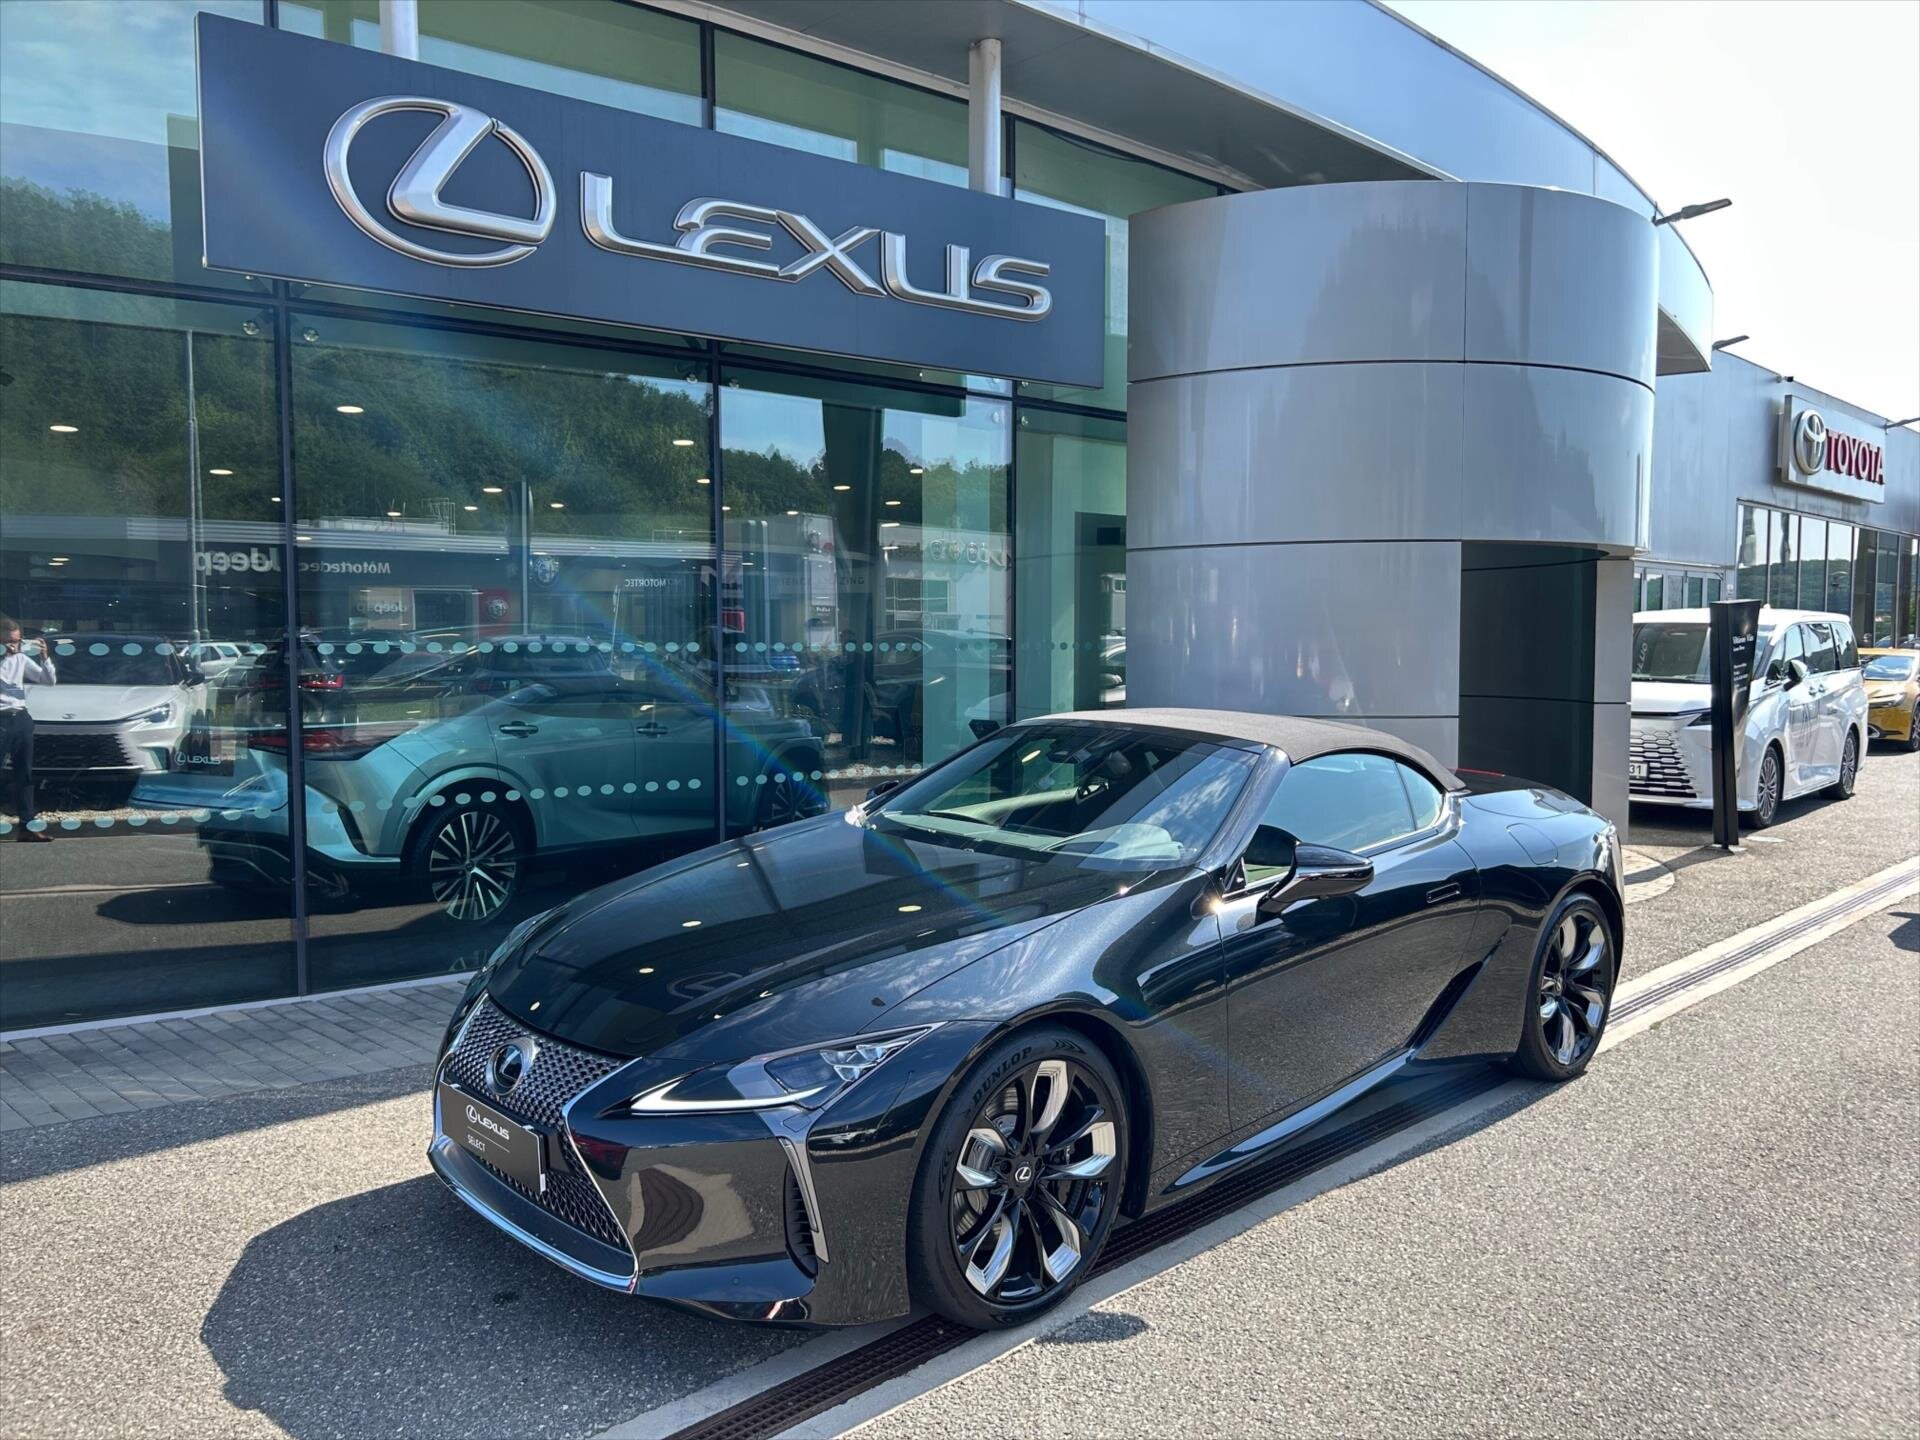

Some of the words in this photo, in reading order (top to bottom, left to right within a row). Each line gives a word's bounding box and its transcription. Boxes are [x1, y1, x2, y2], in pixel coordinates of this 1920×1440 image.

[579, 170, 1054, 323] LEXUS
[1825, 428, 1885, 485] TOYOTA
[974, 1047, 1032, 1105] DUNLOP
[468, 1135, 486, 1151] SELECT
[477, 1114, 509, 1140] LEXUS
